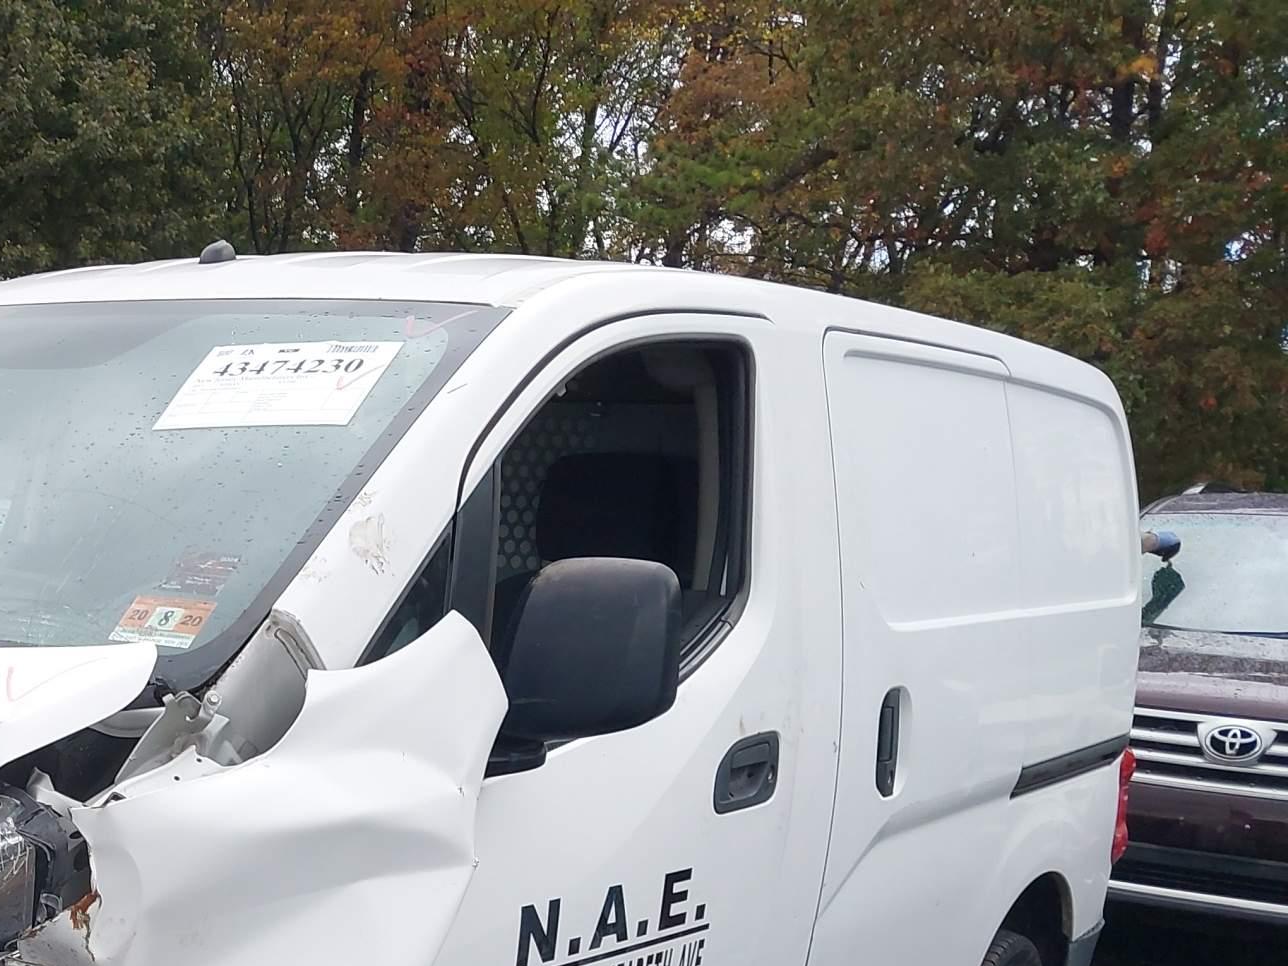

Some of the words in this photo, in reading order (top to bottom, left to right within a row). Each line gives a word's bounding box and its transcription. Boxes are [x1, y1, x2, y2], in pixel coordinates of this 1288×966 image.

[213, 358, 364, 377] 43474230
[128, 608, 150, 621] 20
[158, 610, 175, 626] 8
[180, 615, 203, 627] 20
